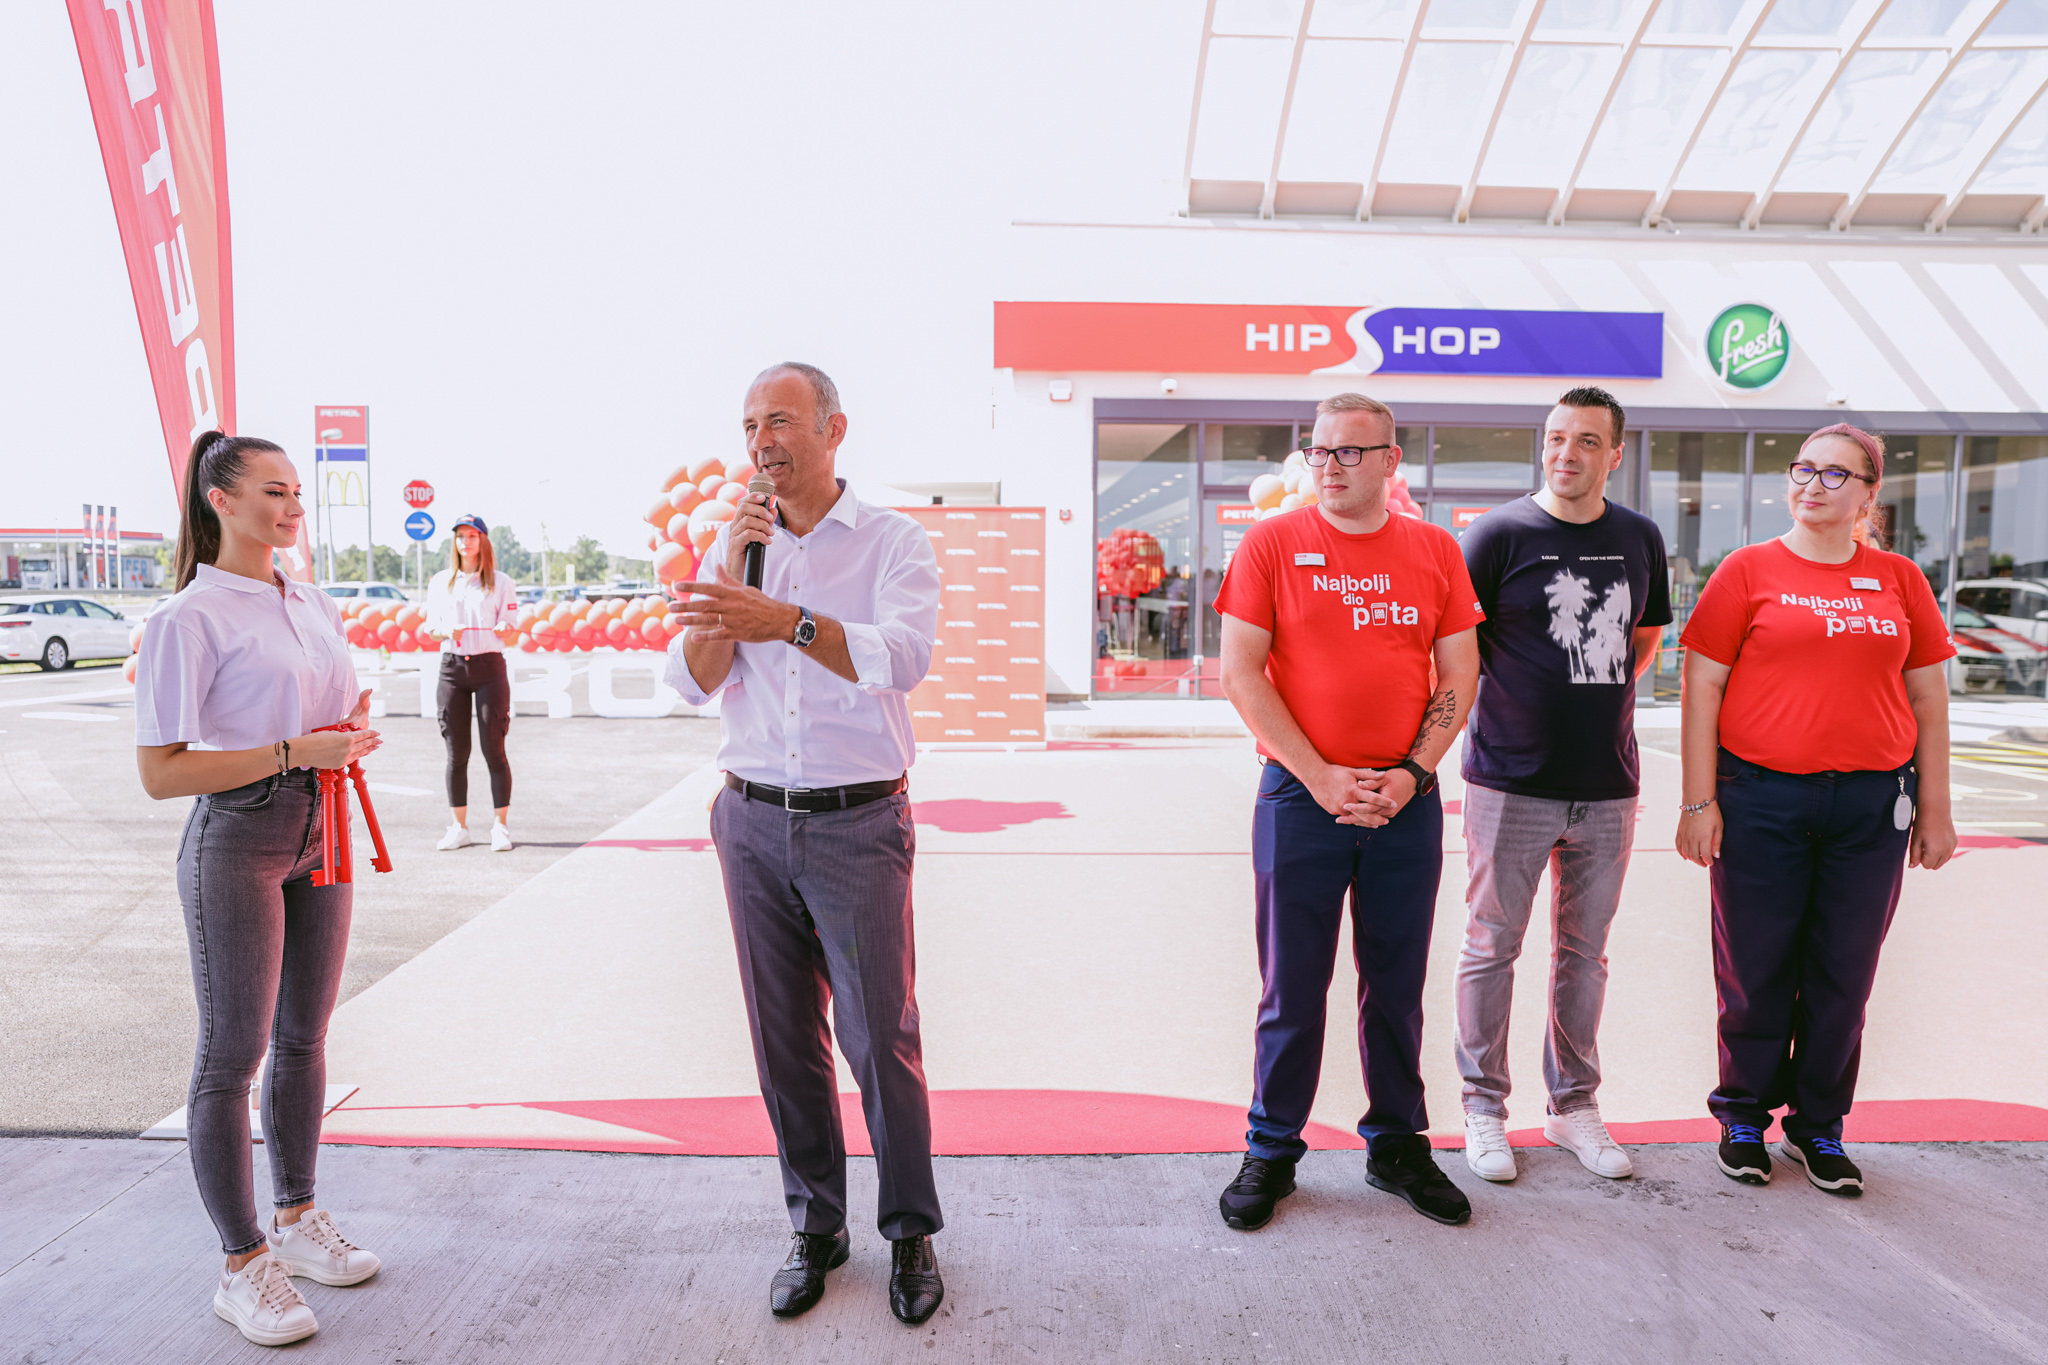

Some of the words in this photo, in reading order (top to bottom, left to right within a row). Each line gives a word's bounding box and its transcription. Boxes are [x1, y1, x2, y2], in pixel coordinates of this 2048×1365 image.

[1246, 323, 1331, 352] HIP
[1718, 312, 1784, 382] fresh
[404, 487, 434, 502] STOP
[1313, 574, 1391, 595] Najbolji
[1343, 593, 1364, 606] dio
[1781, 593, 1864, 611] Najbolji
[1814, 608, 1838, 618] dio
